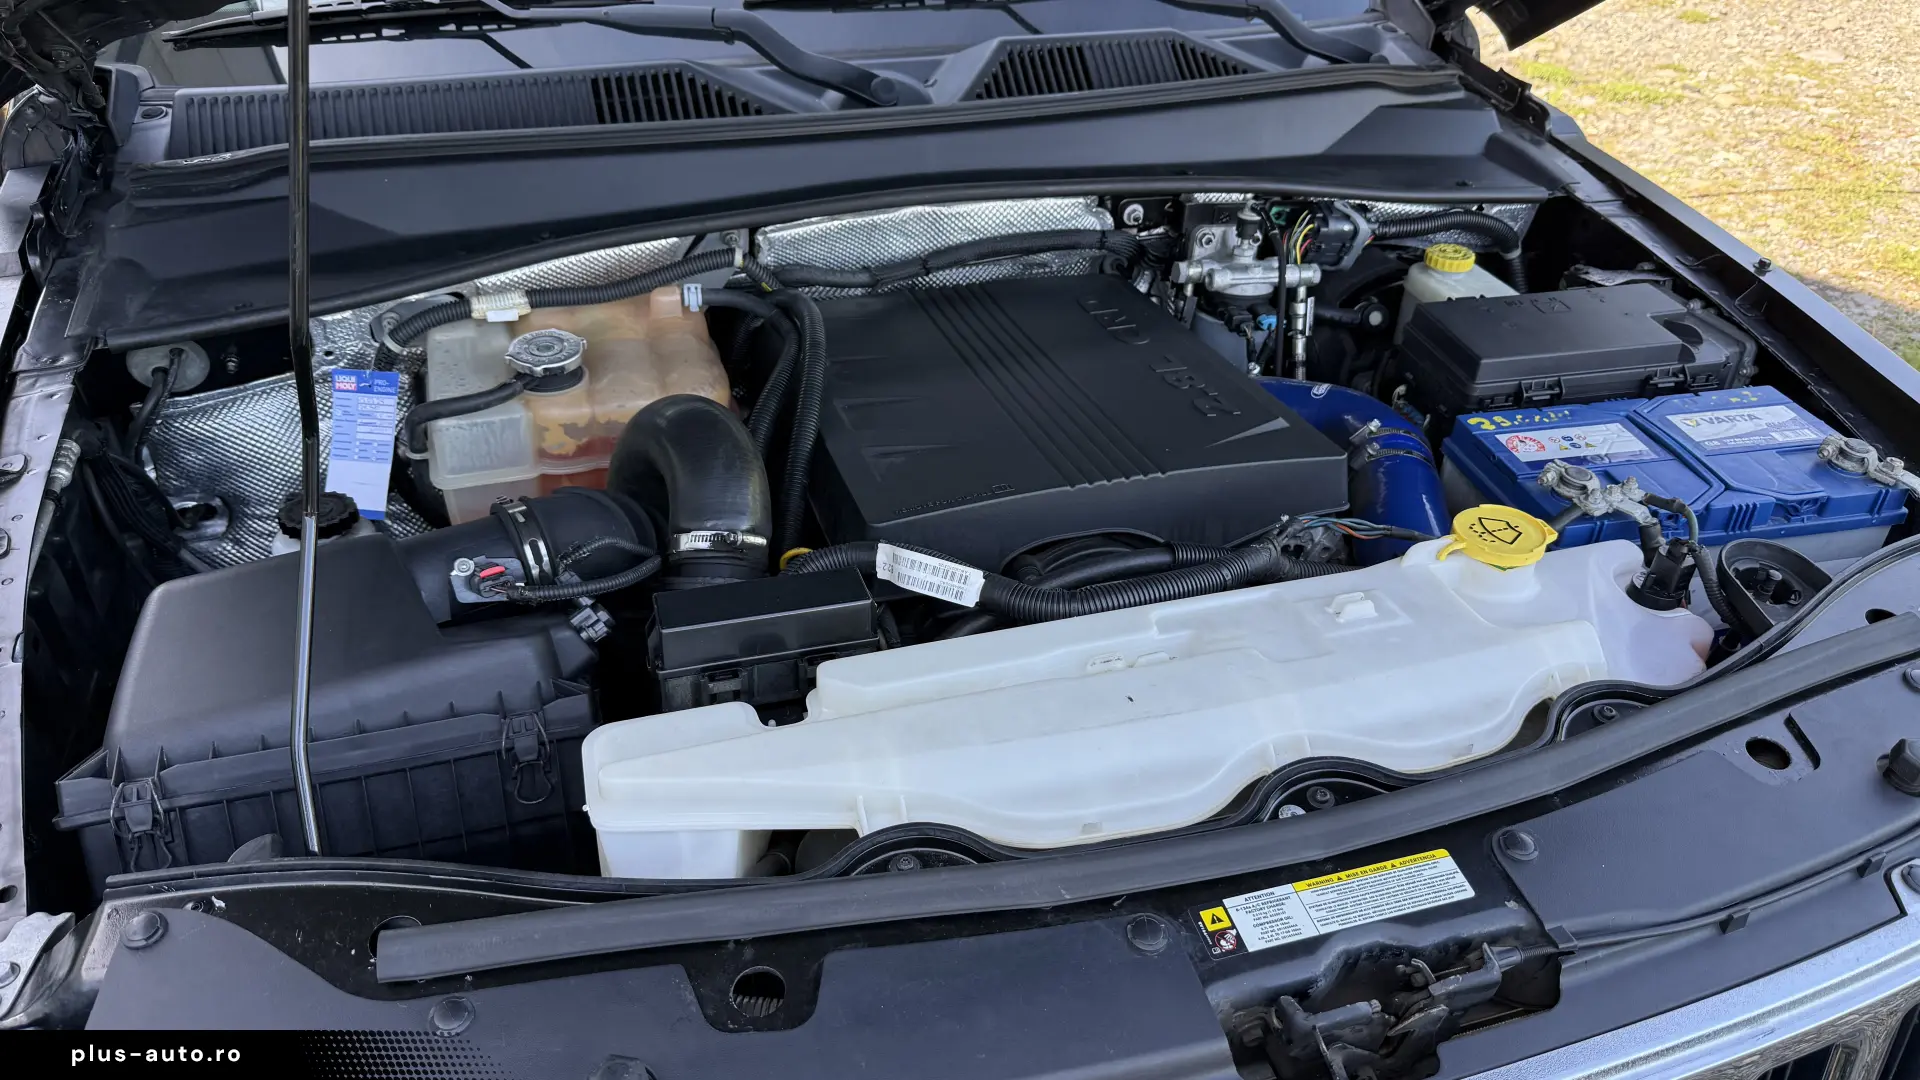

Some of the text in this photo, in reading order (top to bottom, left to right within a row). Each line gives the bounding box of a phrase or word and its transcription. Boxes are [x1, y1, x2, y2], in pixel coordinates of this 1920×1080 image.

[335, 382, 357, 391] MOLY
[373, 385, 397, 393] ENGINE
[1700, 413, 1763, 425] VARTA
[1305, 877, 1335, 888] WARNING
[1345, 871, 1360, 879] MISE
[1369, 864, 1388, 873] GARDE
[1399, 853, 1437, 866] ADVERTENCIA
[1244, 891, 1275, 902] ATTENTION
